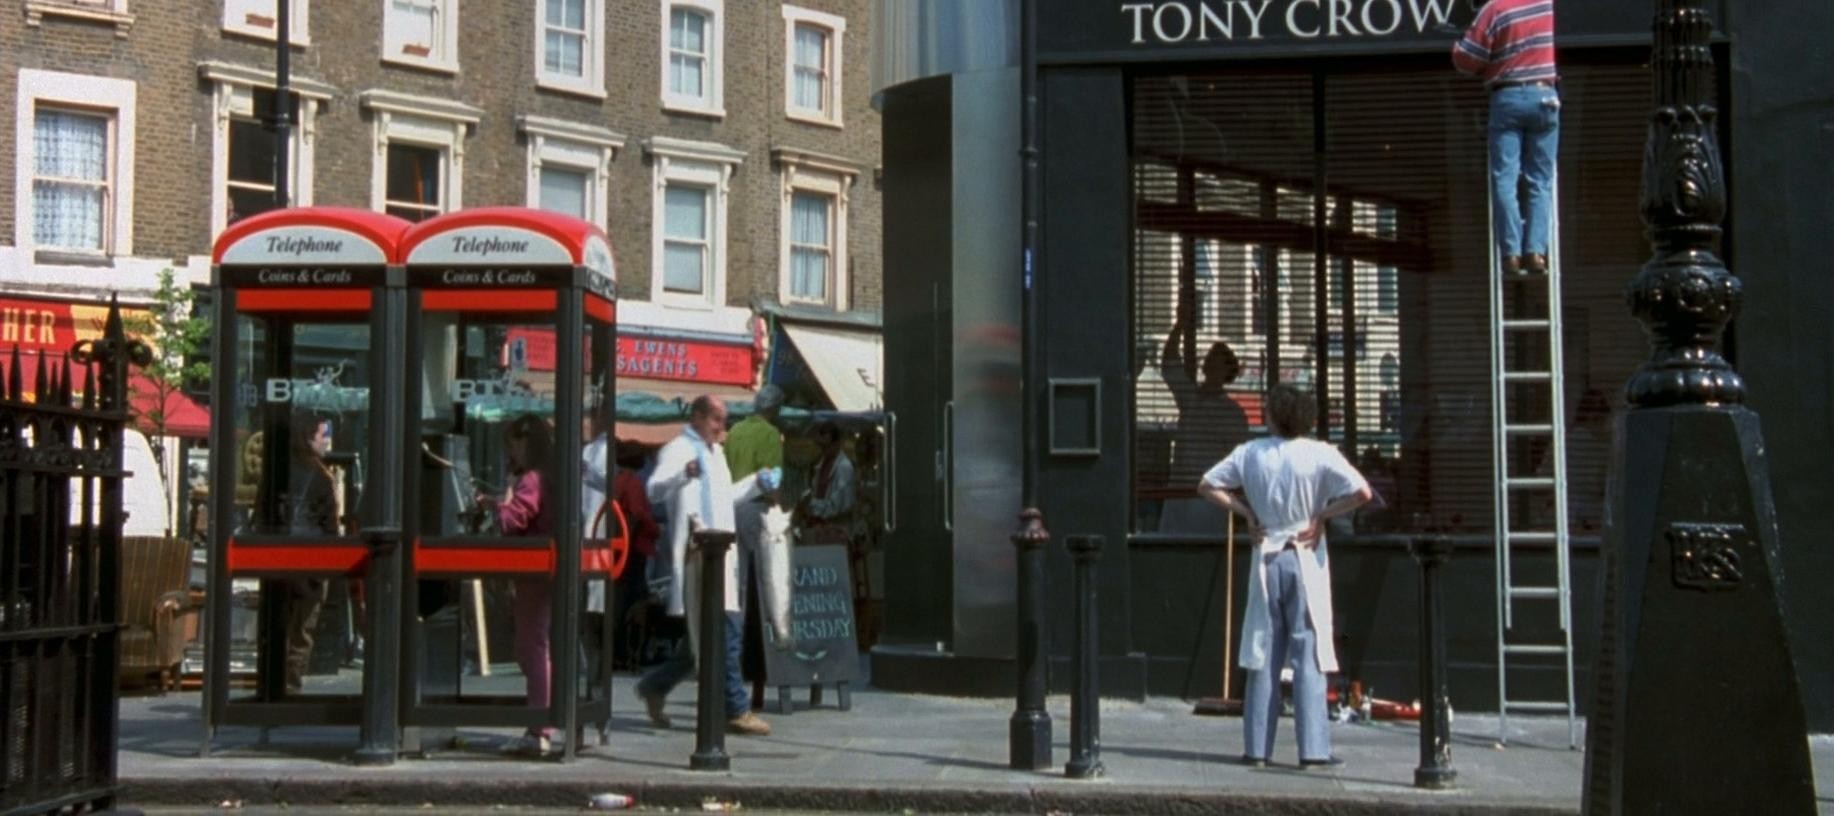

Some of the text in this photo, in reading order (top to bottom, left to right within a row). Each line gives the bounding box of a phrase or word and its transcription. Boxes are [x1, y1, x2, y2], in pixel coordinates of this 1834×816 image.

[1120, 0, 1273, 44] TONY
[266, 236, 343, 256] Telephone
[452, 236, 529, 256] Telephone
[258, 269, 352, 284] Coins & Cards
[442, 269, 536, 284] Coins & Cards
[2, 307, 56, 344] HER
[634, 340, 687, 357] EWENS
[616, 353, 697, 376] SAGENTS
[792, 567, 838, 587] RAND
[794, 592, 847, 615] ENING
